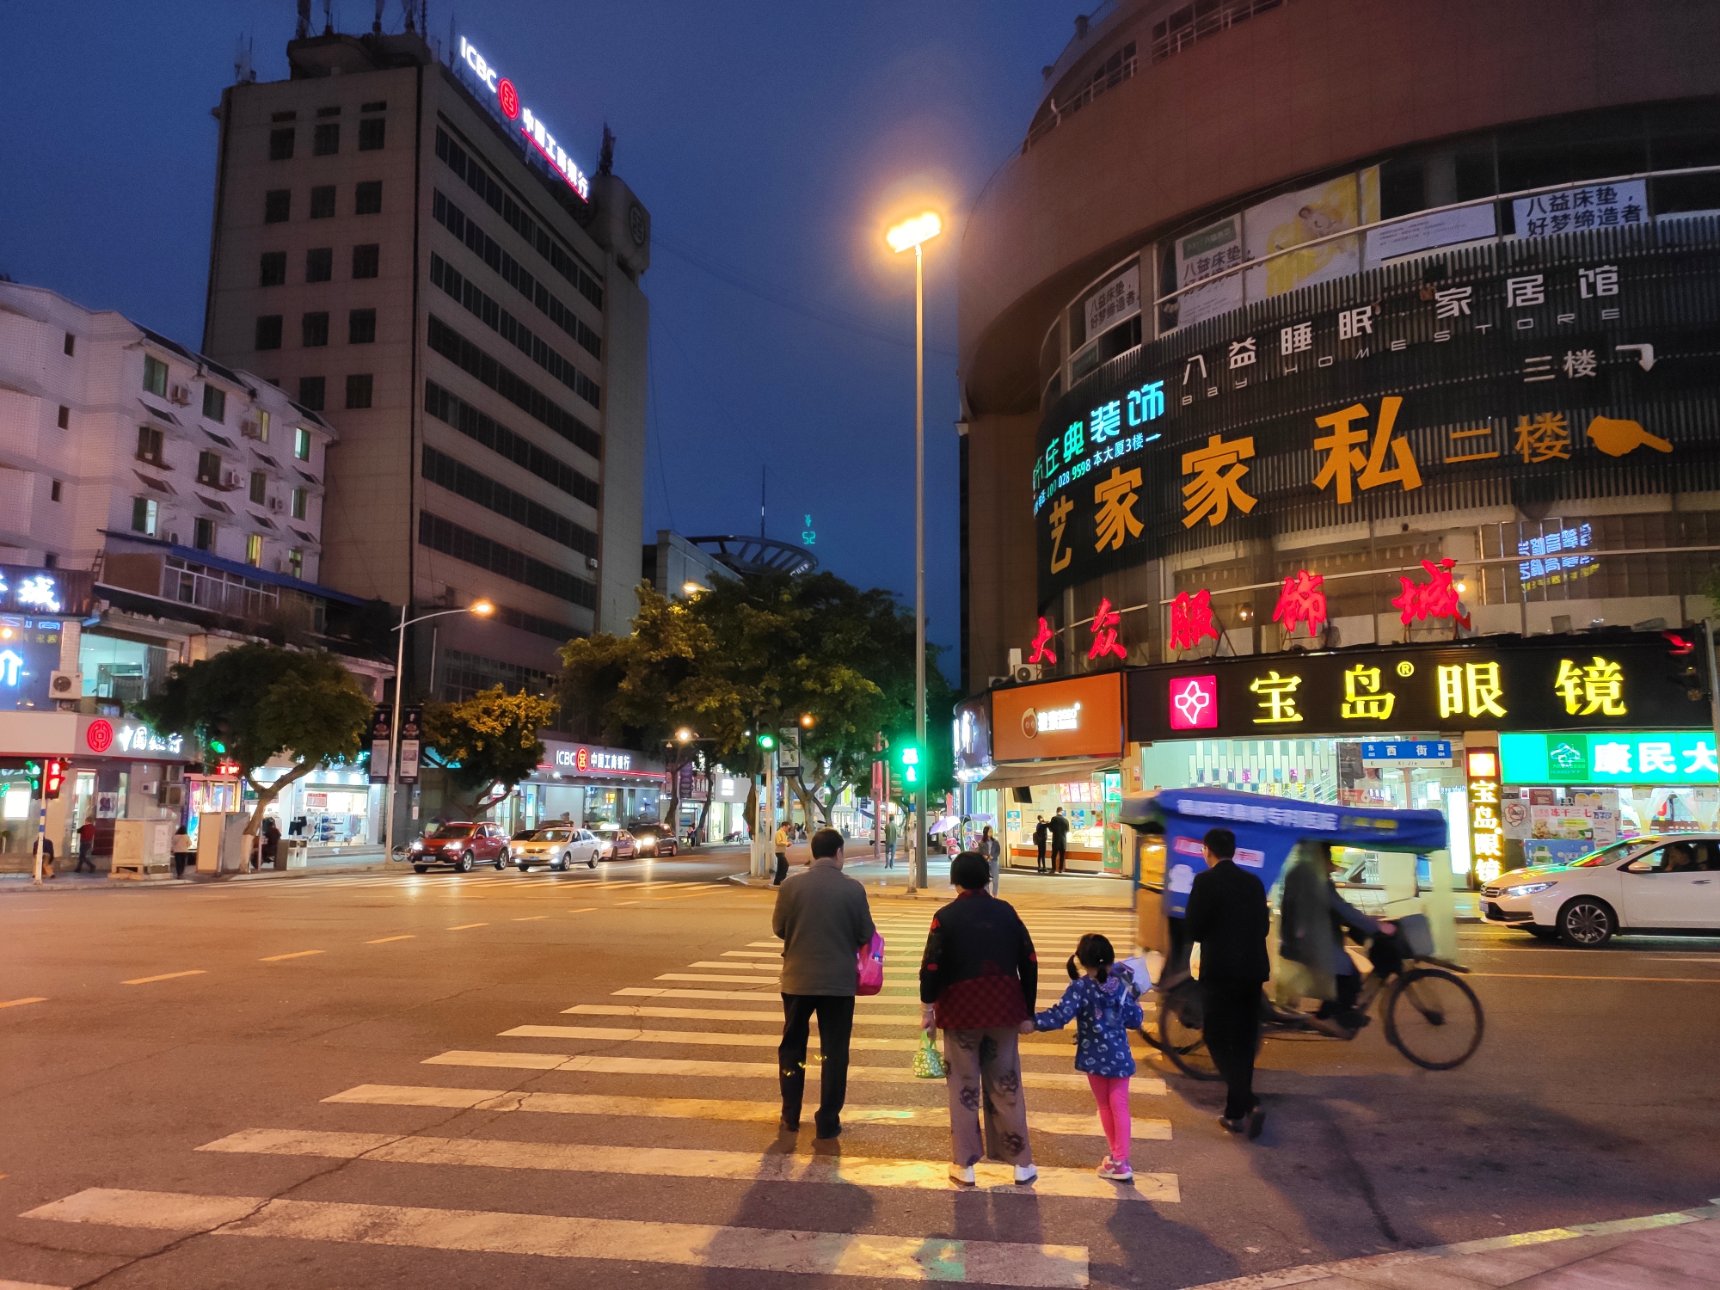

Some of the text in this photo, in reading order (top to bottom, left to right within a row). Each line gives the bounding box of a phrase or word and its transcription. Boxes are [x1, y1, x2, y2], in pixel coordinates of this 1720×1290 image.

[461, 36, 497, 93] ICBC
[1528, 205, 1642, 238] 好梦缔造者
[1523, 349, 1597, 383] 三楼
[1445, 411, 1572, 465] 二楼
[1072, 458, 1091, 480] 9598
[556, 750, 576, 766] ICBC
